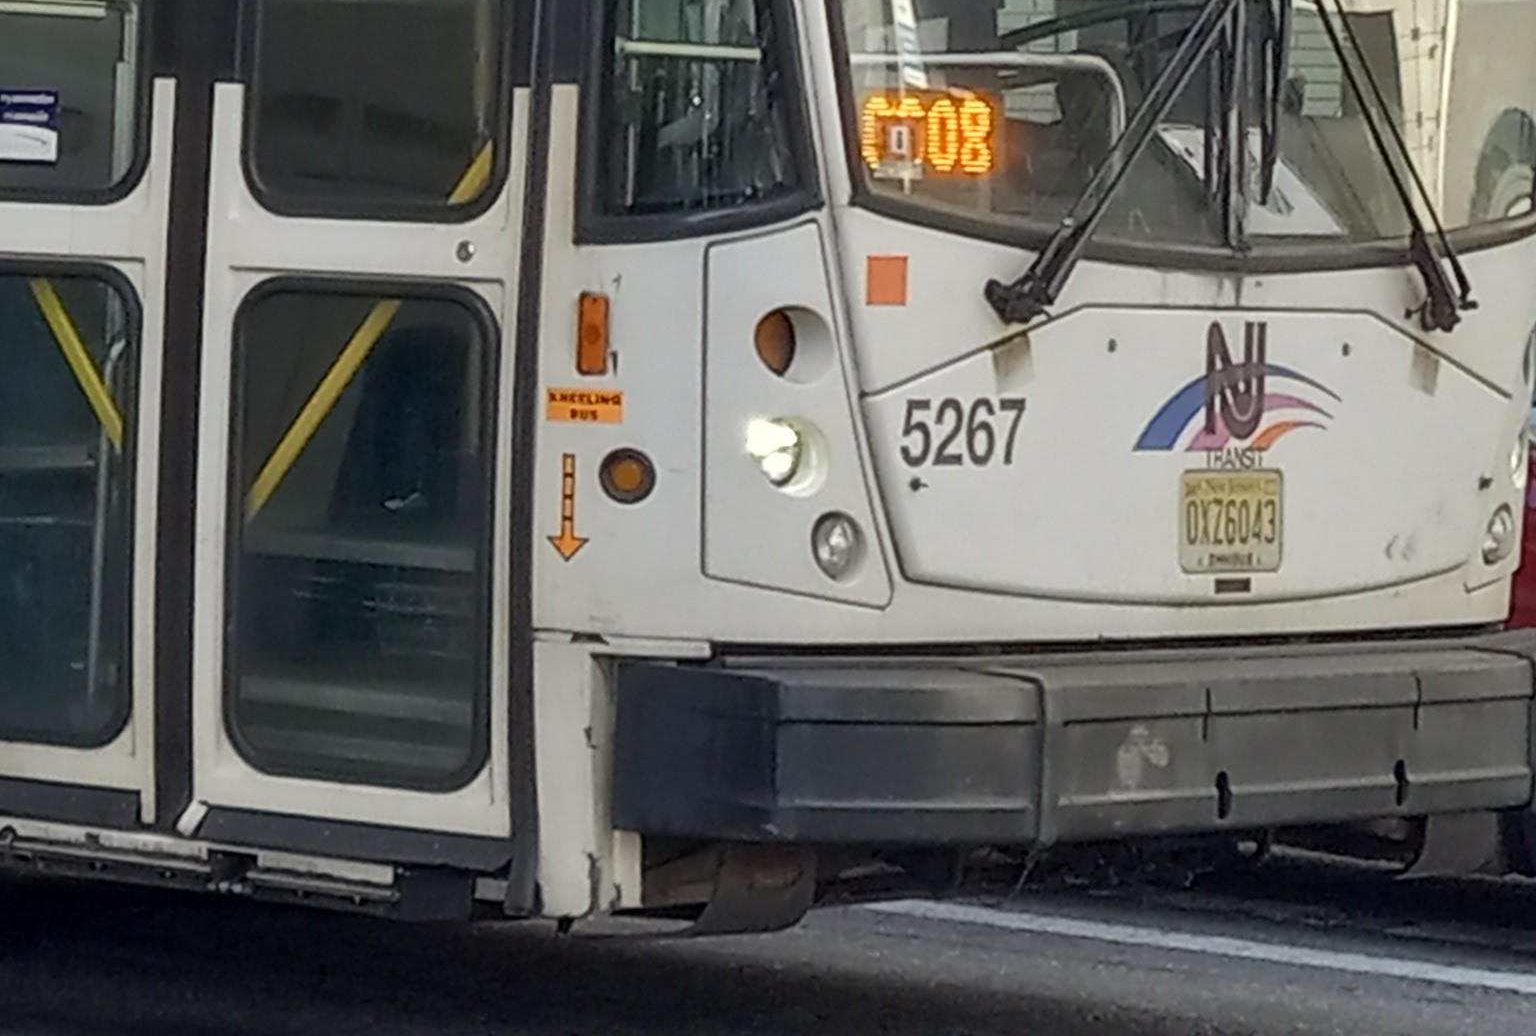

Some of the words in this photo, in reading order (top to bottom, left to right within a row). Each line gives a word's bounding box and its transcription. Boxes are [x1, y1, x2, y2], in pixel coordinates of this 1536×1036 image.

[570, 408, 598, 420] BUS
[900, 397, 1026, 467] 5267
[1206, 447, 1265, 470] TRANSIT
